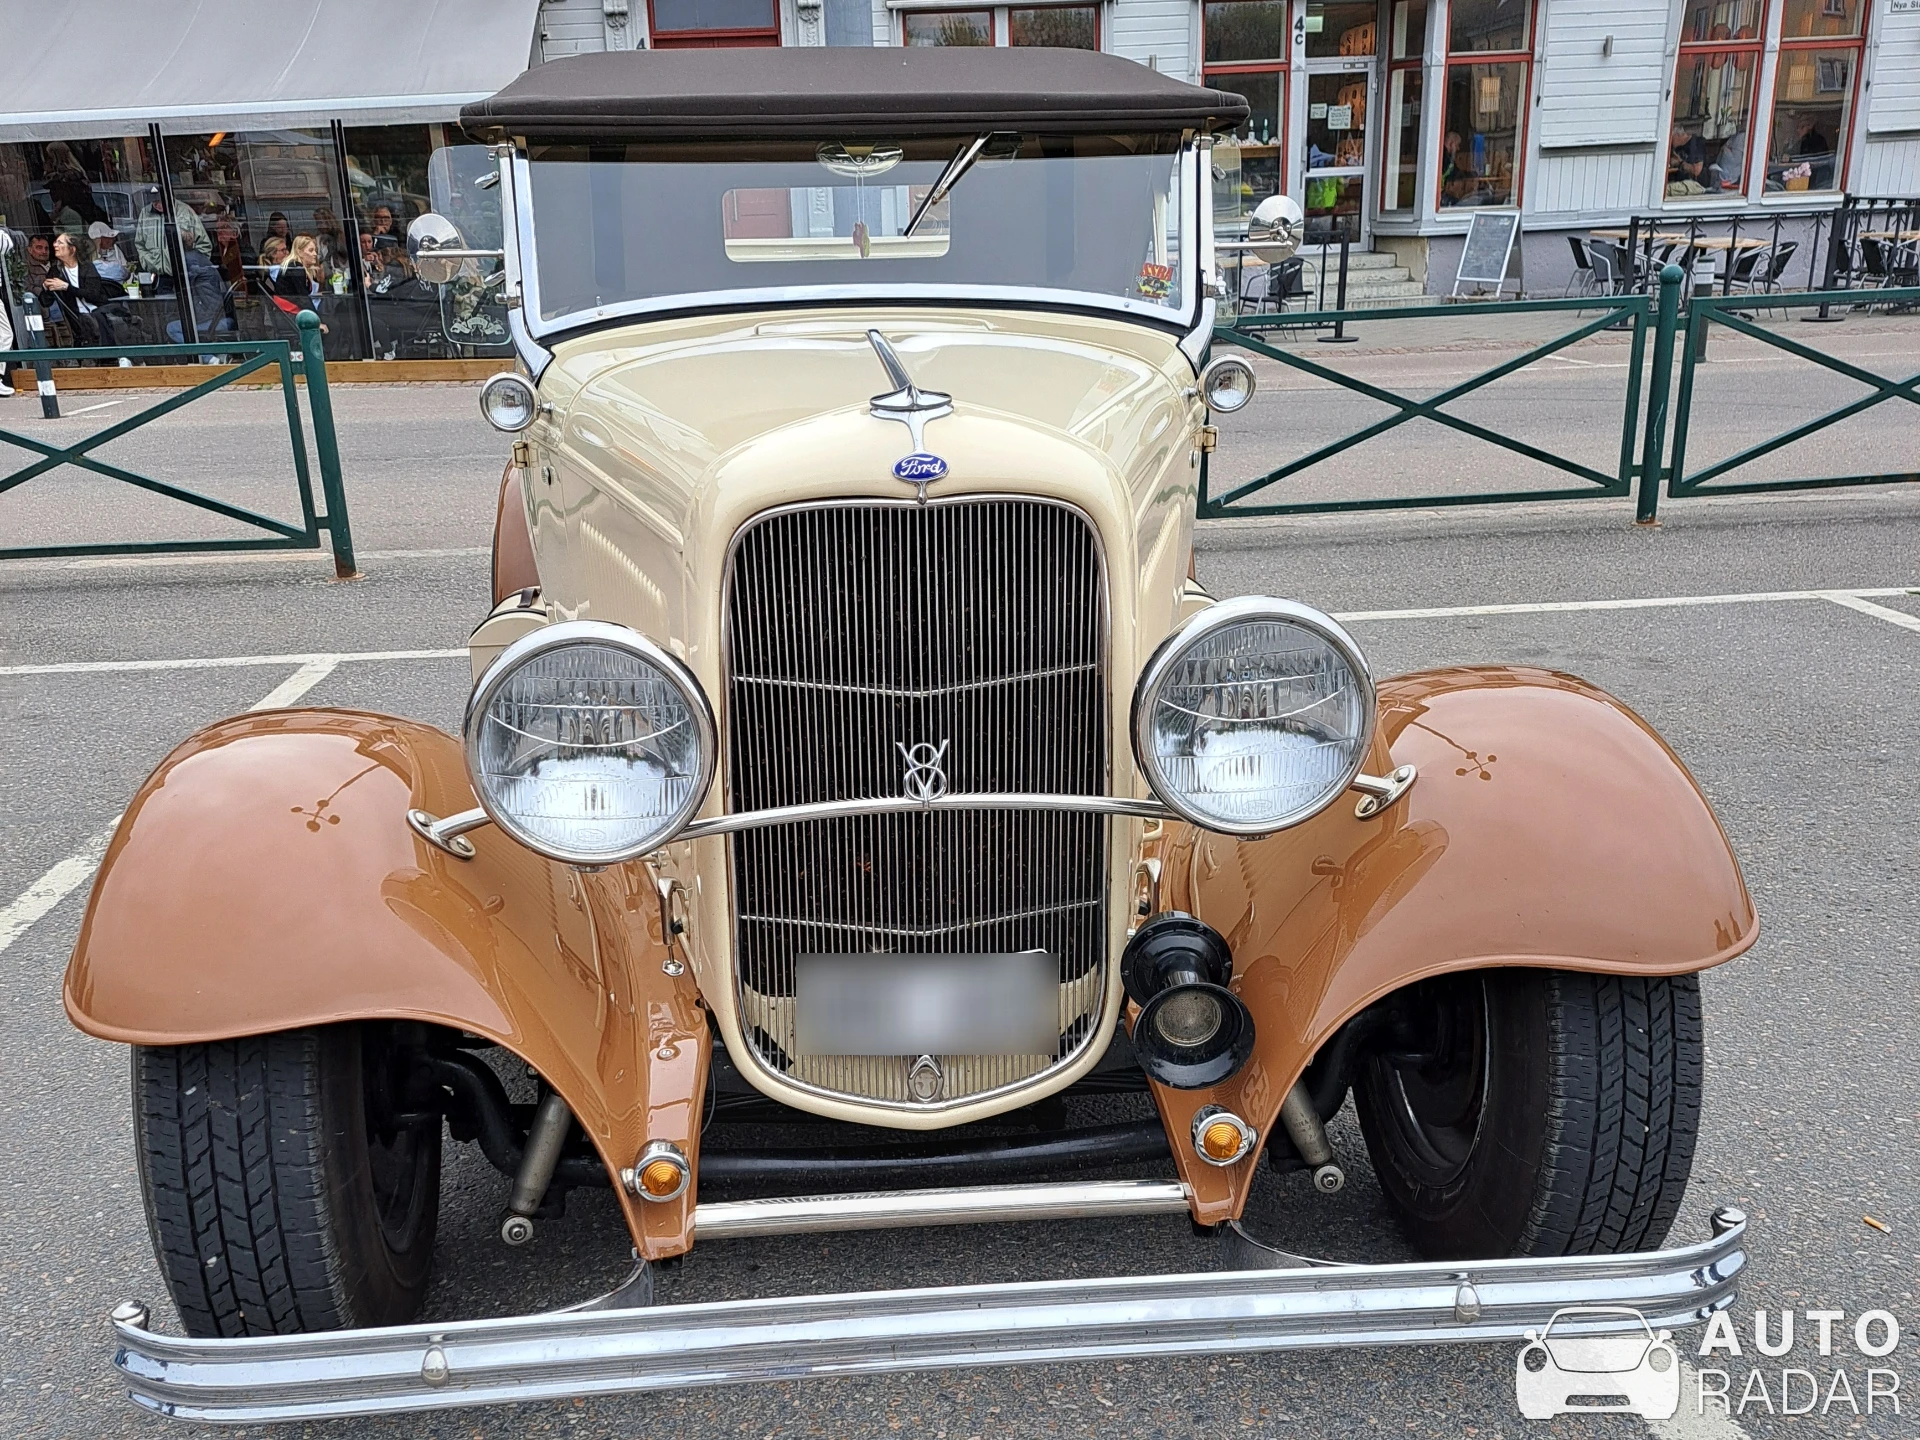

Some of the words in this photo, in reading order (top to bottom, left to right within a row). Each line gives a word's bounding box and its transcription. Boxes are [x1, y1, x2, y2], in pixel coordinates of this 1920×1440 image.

[1893, 1, 1908, 9] Nya
[1910, 0, 1920, 8] St
[1294, 15, 1305, 32] 4
[1294, 34, 1304, 45] C
[900, 456, 944, 477] Ford
